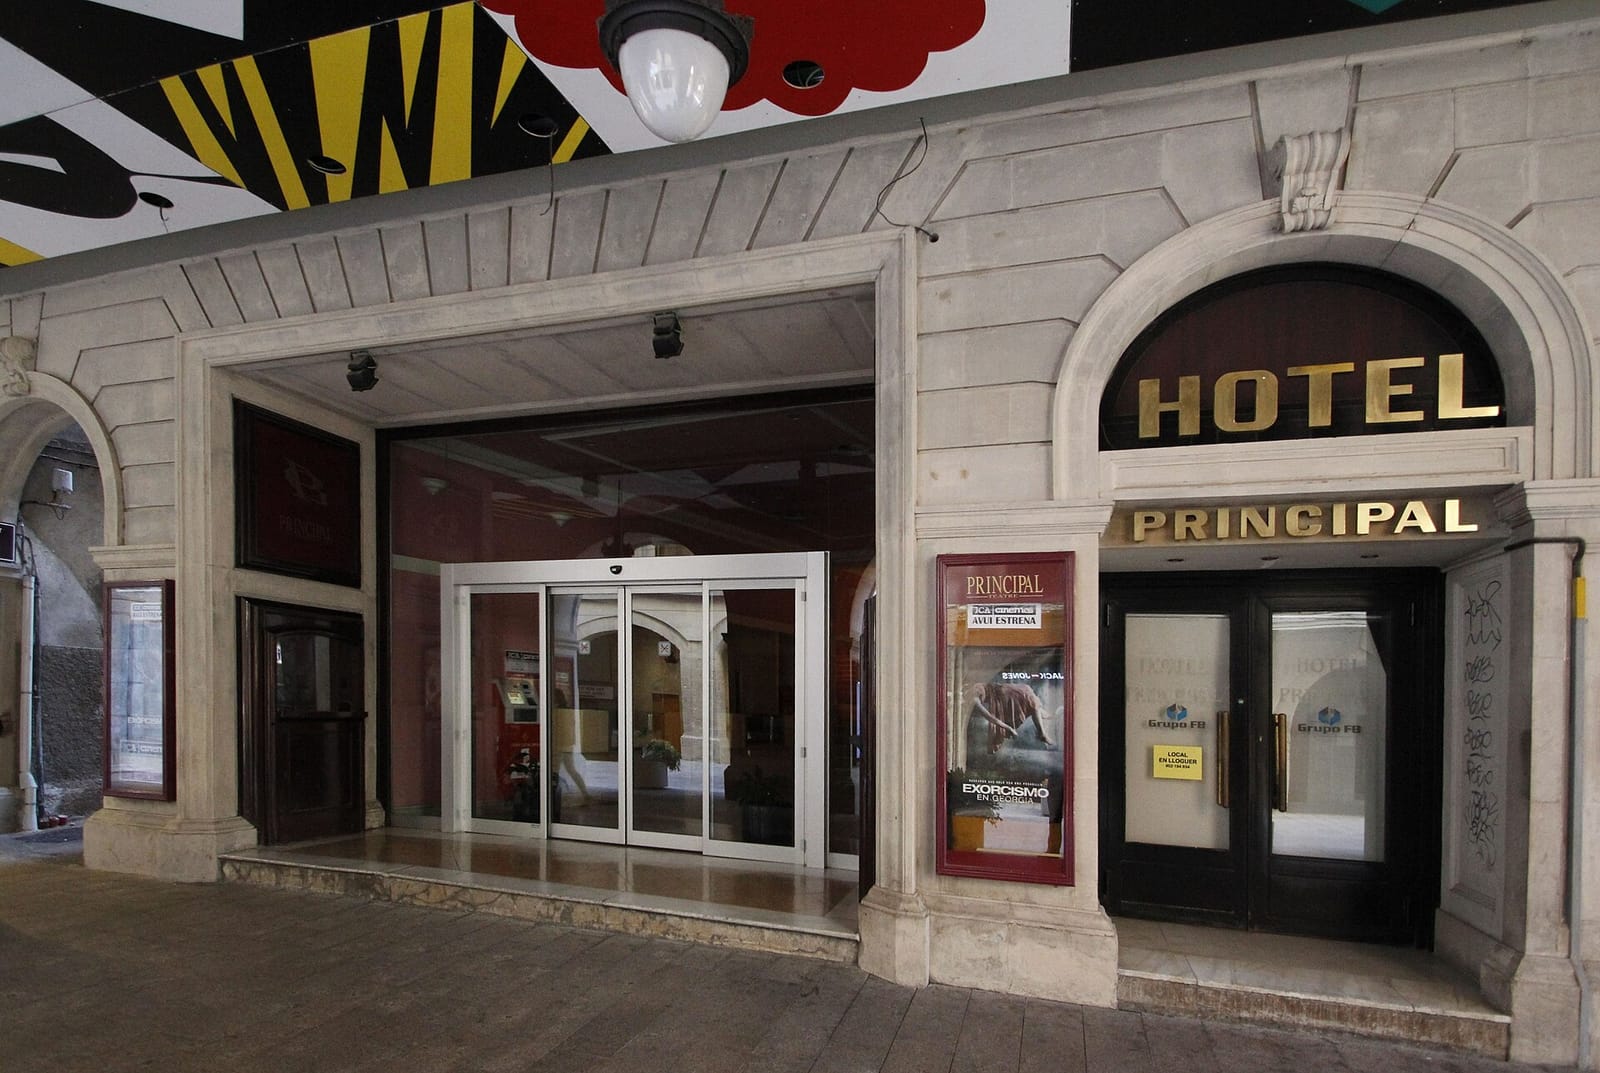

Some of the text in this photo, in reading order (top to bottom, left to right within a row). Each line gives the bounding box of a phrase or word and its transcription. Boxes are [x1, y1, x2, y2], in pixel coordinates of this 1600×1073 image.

[1138, 353, 1500, 439] HOTEL
[1133, 498, 1480, 542] PRINCIPAL
[967, 574, 1044, 595] PRINCIPAL
[972, 616, 1036, 625] AVUI ESTRENA
[1148, 719, 1187, 730] Grupo
[1298, 723, 1340, 734] Grupo
[962, 783, 1050, 798] EXORCISMO
[976, 793, 989, 801] EN
